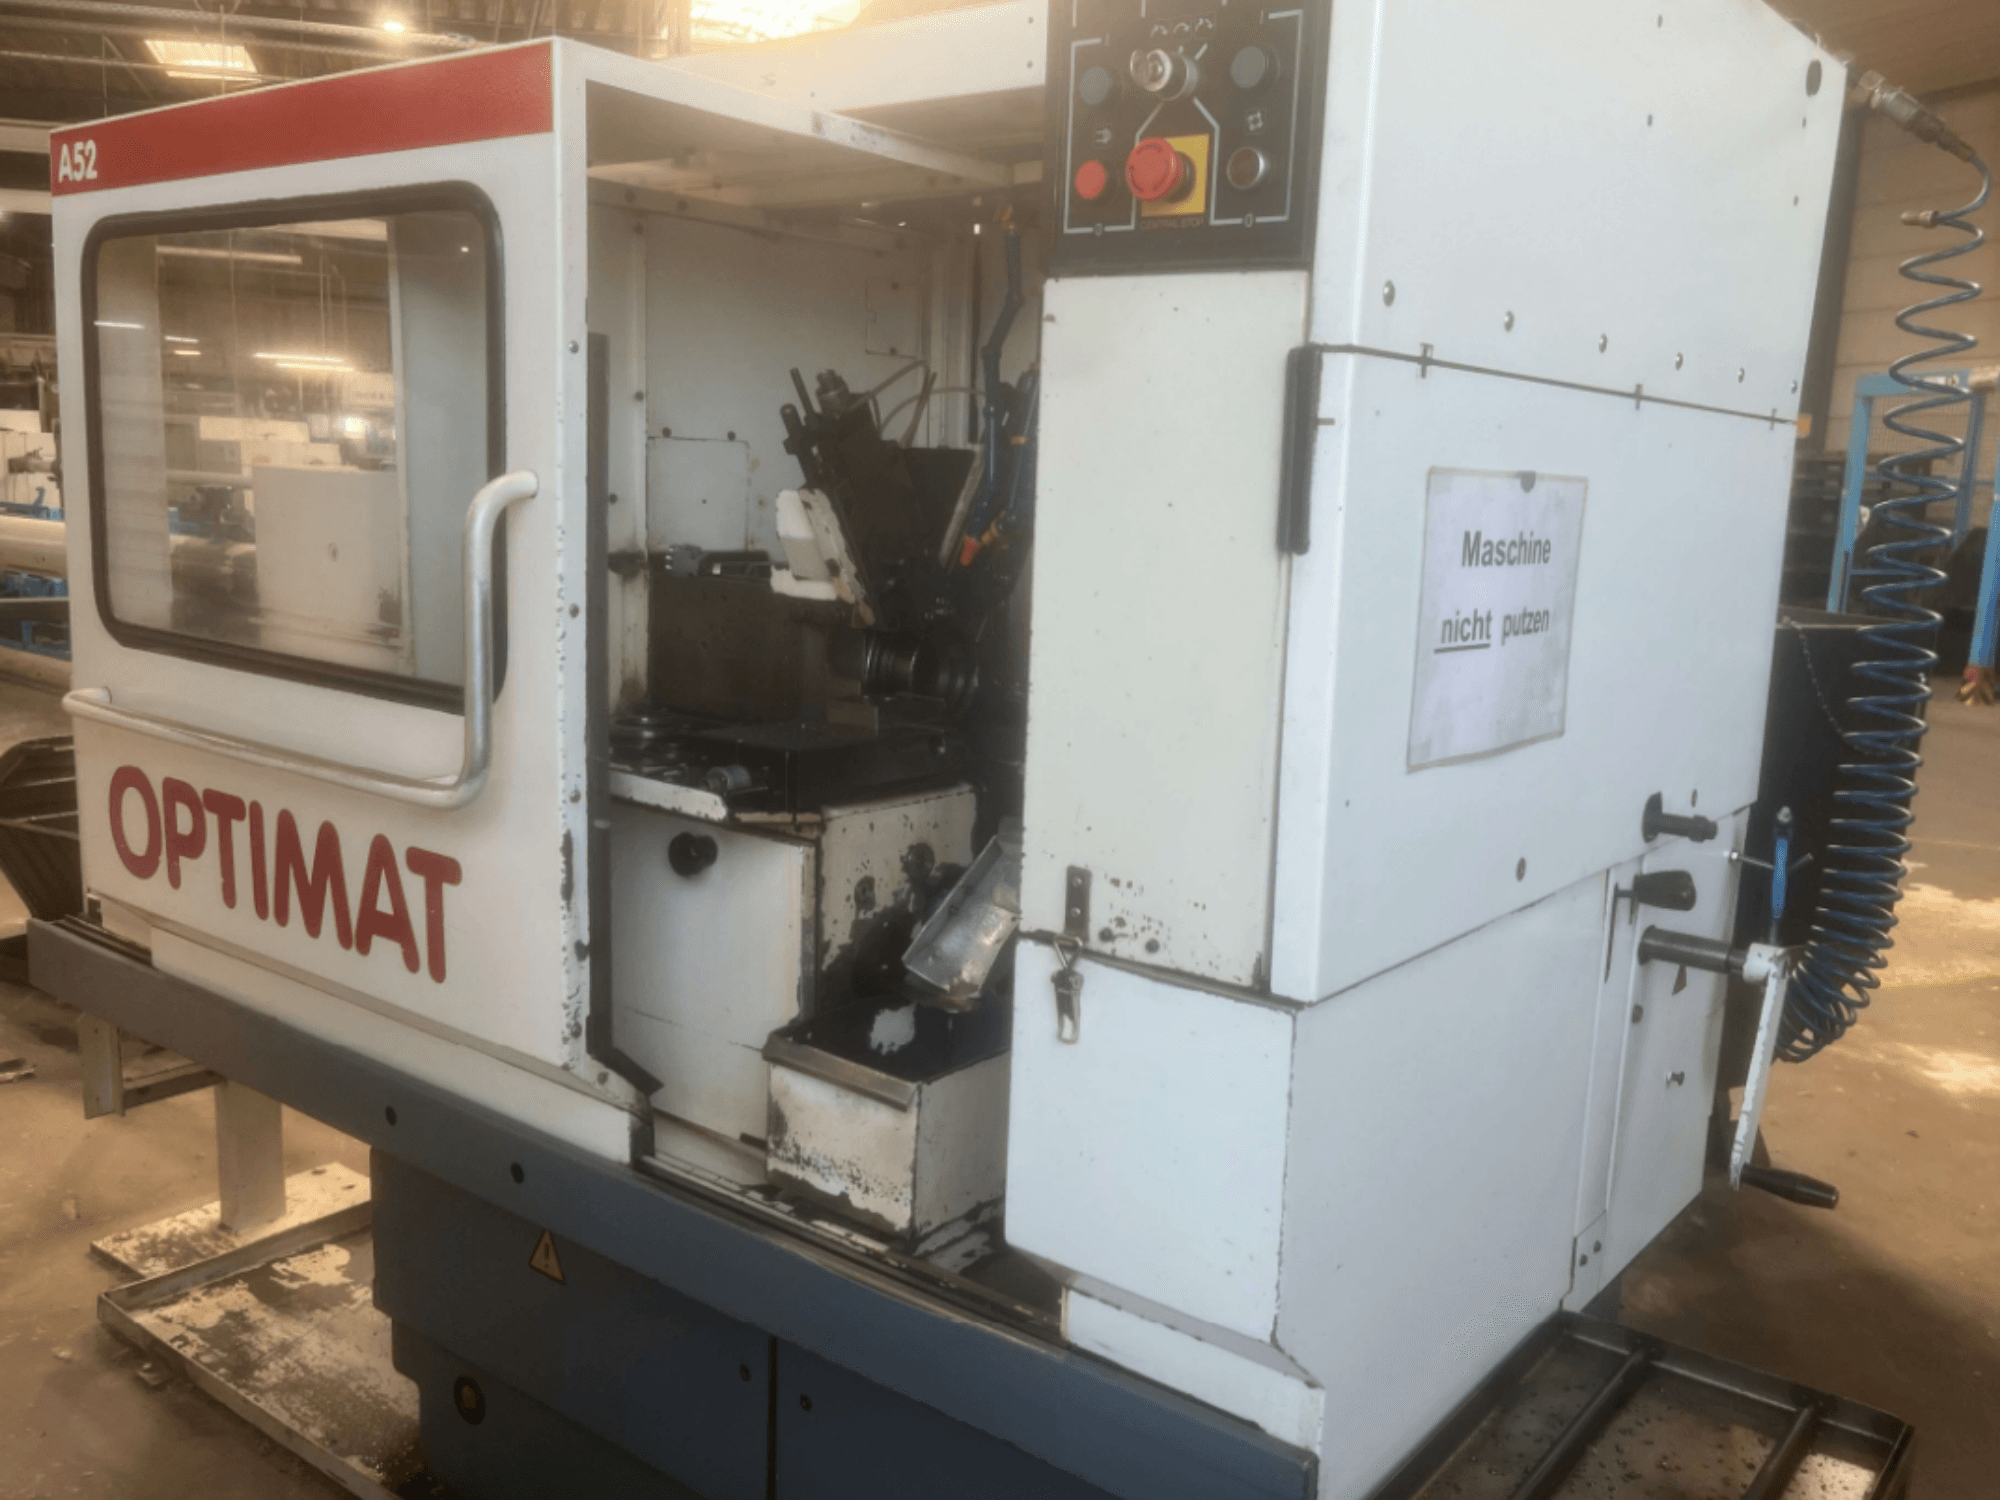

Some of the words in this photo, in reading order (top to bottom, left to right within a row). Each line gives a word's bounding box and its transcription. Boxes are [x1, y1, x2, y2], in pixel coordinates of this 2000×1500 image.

[59, 139, 98, 182] A52
[1461, 530, 1551, 567] Maschine
[1440, 608, 1493, 644] nicht
[1501, 608, 1549, 646] putzen
[109, 765, 462, 984] OPTIMAT
